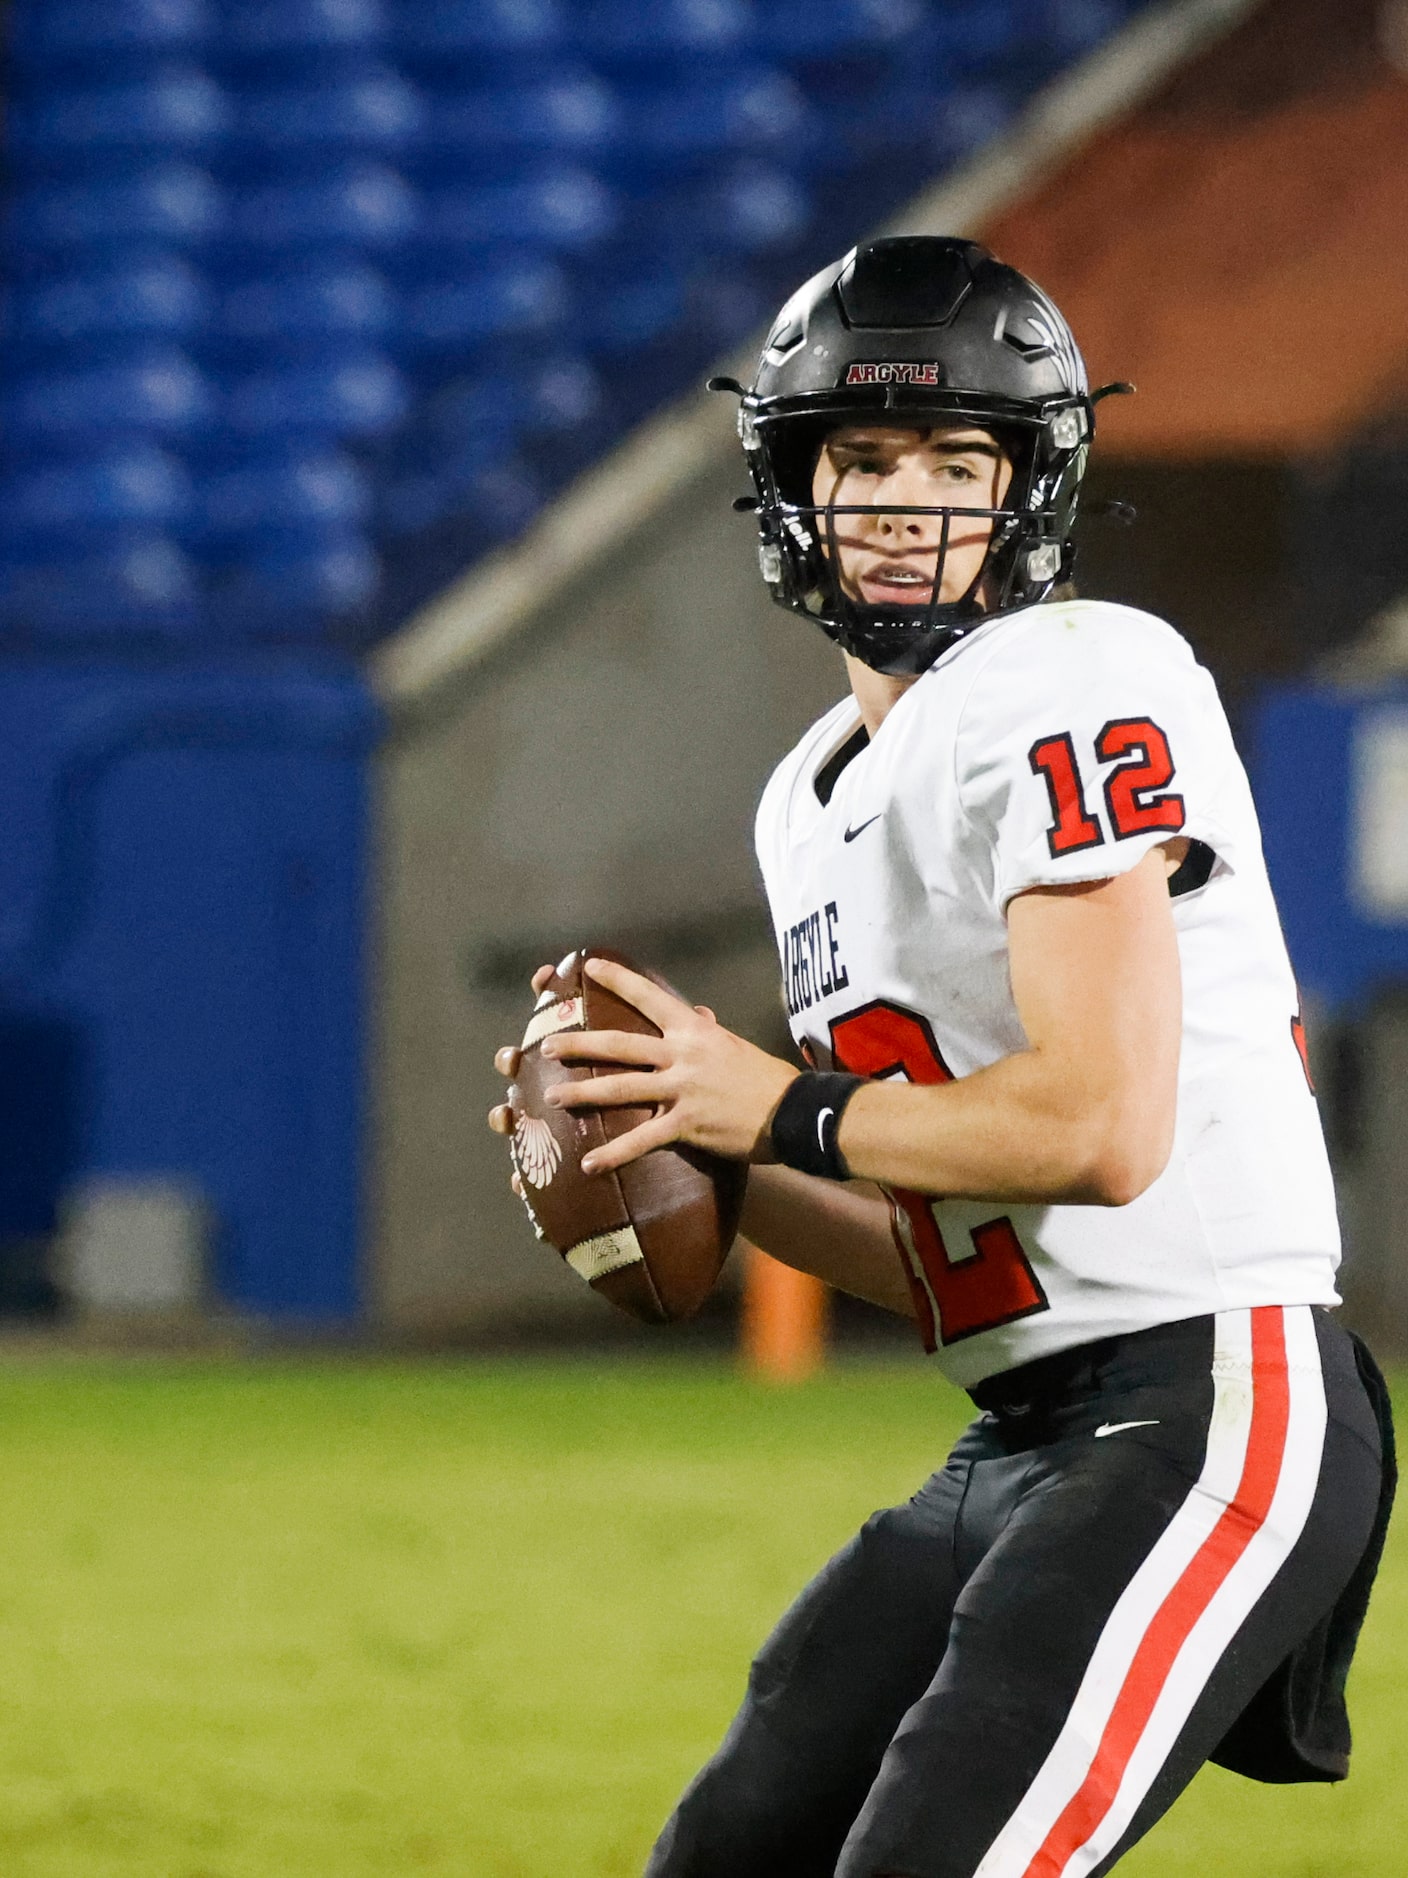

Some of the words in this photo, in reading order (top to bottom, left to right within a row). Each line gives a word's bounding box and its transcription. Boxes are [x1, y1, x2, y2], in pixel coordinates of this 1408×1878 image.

[846, 363, 939, 385] ARGYLE
[1028, 716, 1186, 860] 12
[799, 998, 1051, 1354] 2
